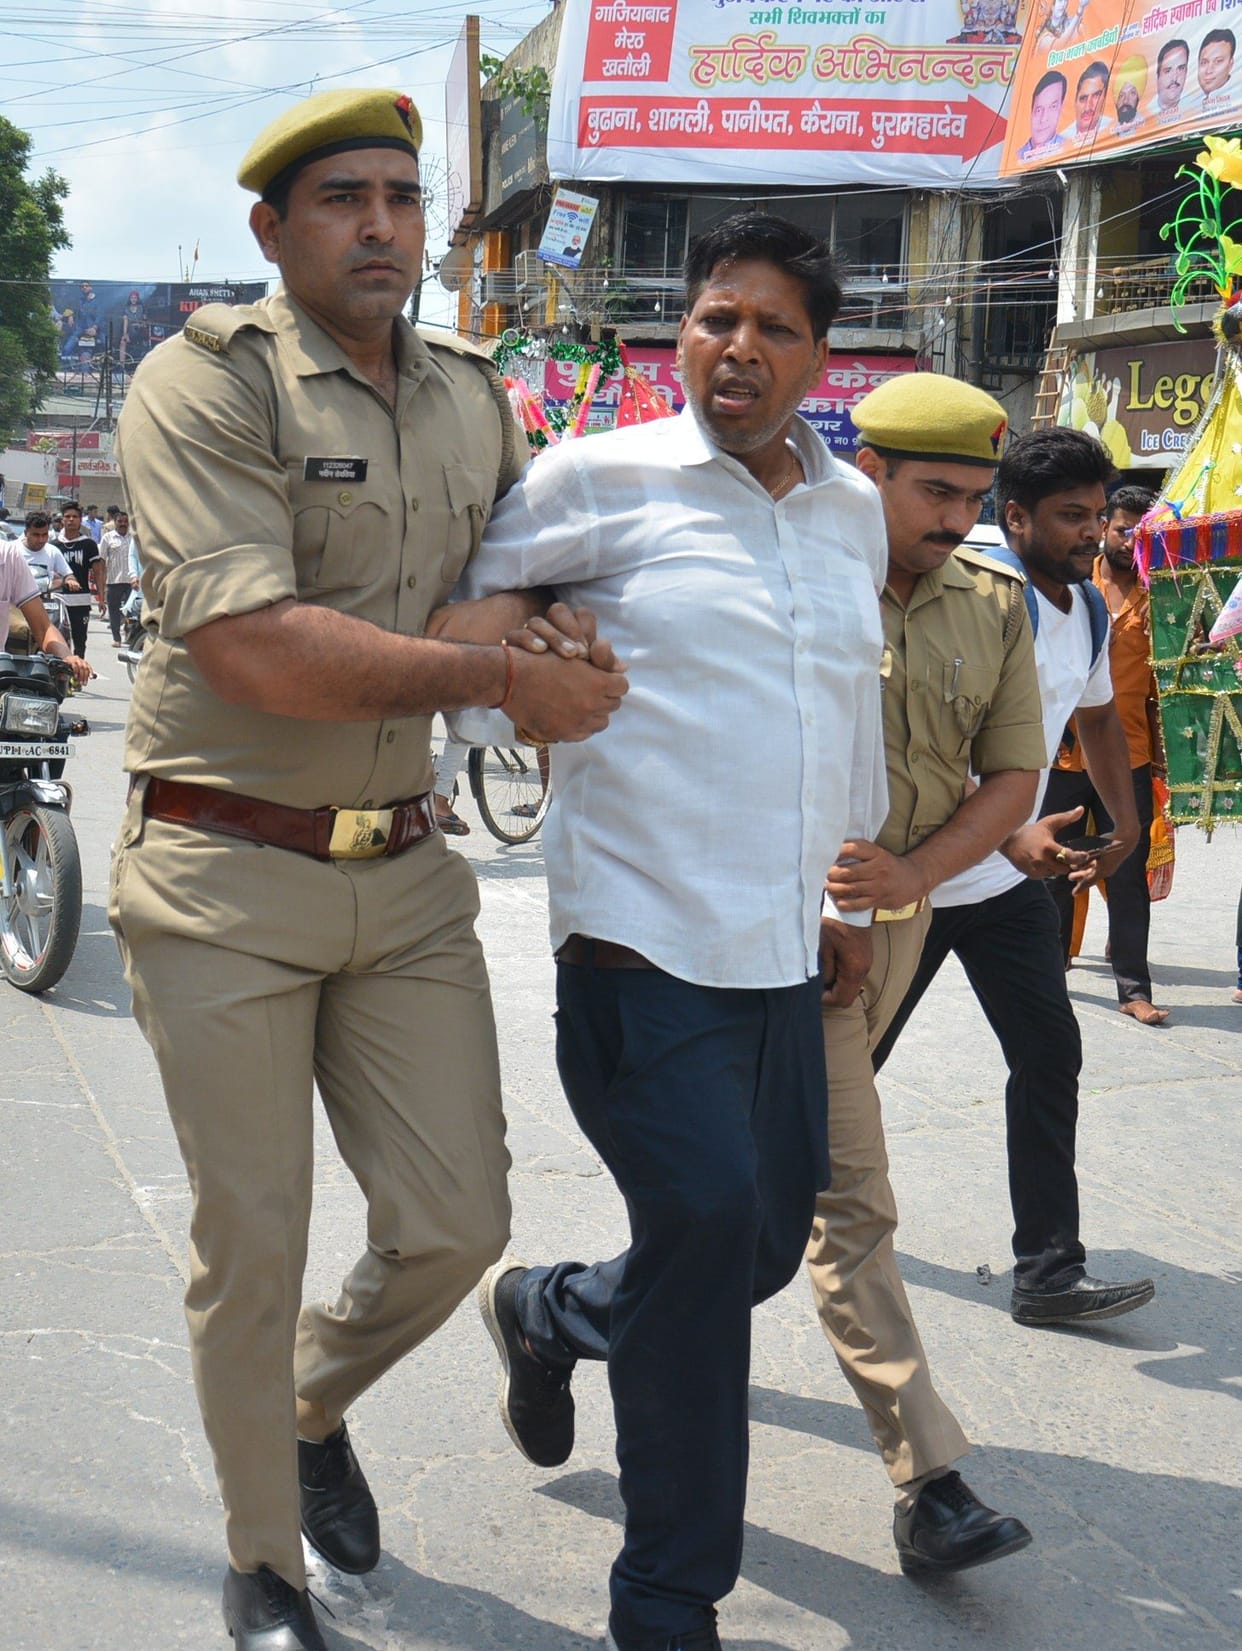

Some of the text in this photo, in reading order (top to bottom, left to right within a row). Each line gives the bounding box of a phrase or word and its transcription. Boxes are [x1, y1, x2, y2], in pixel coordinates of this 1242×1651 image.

[750, 7, 886, 25] सभी शिवभक्तों का
[614, 28, 646, 49] मेरठ
[602, 52, 651, 77] खतौली
[690, 32, 1016, 88] हार्दिक अभिनन्दन
[648, 99, 714, 134] शामली,
[721, 99, 794, 136] पानीपत,
[800, 99, 864, 137] कैराना,
[870, 104, 967, 149] पुरामहादेव
[1162, 428, 1190, 449] CRE
